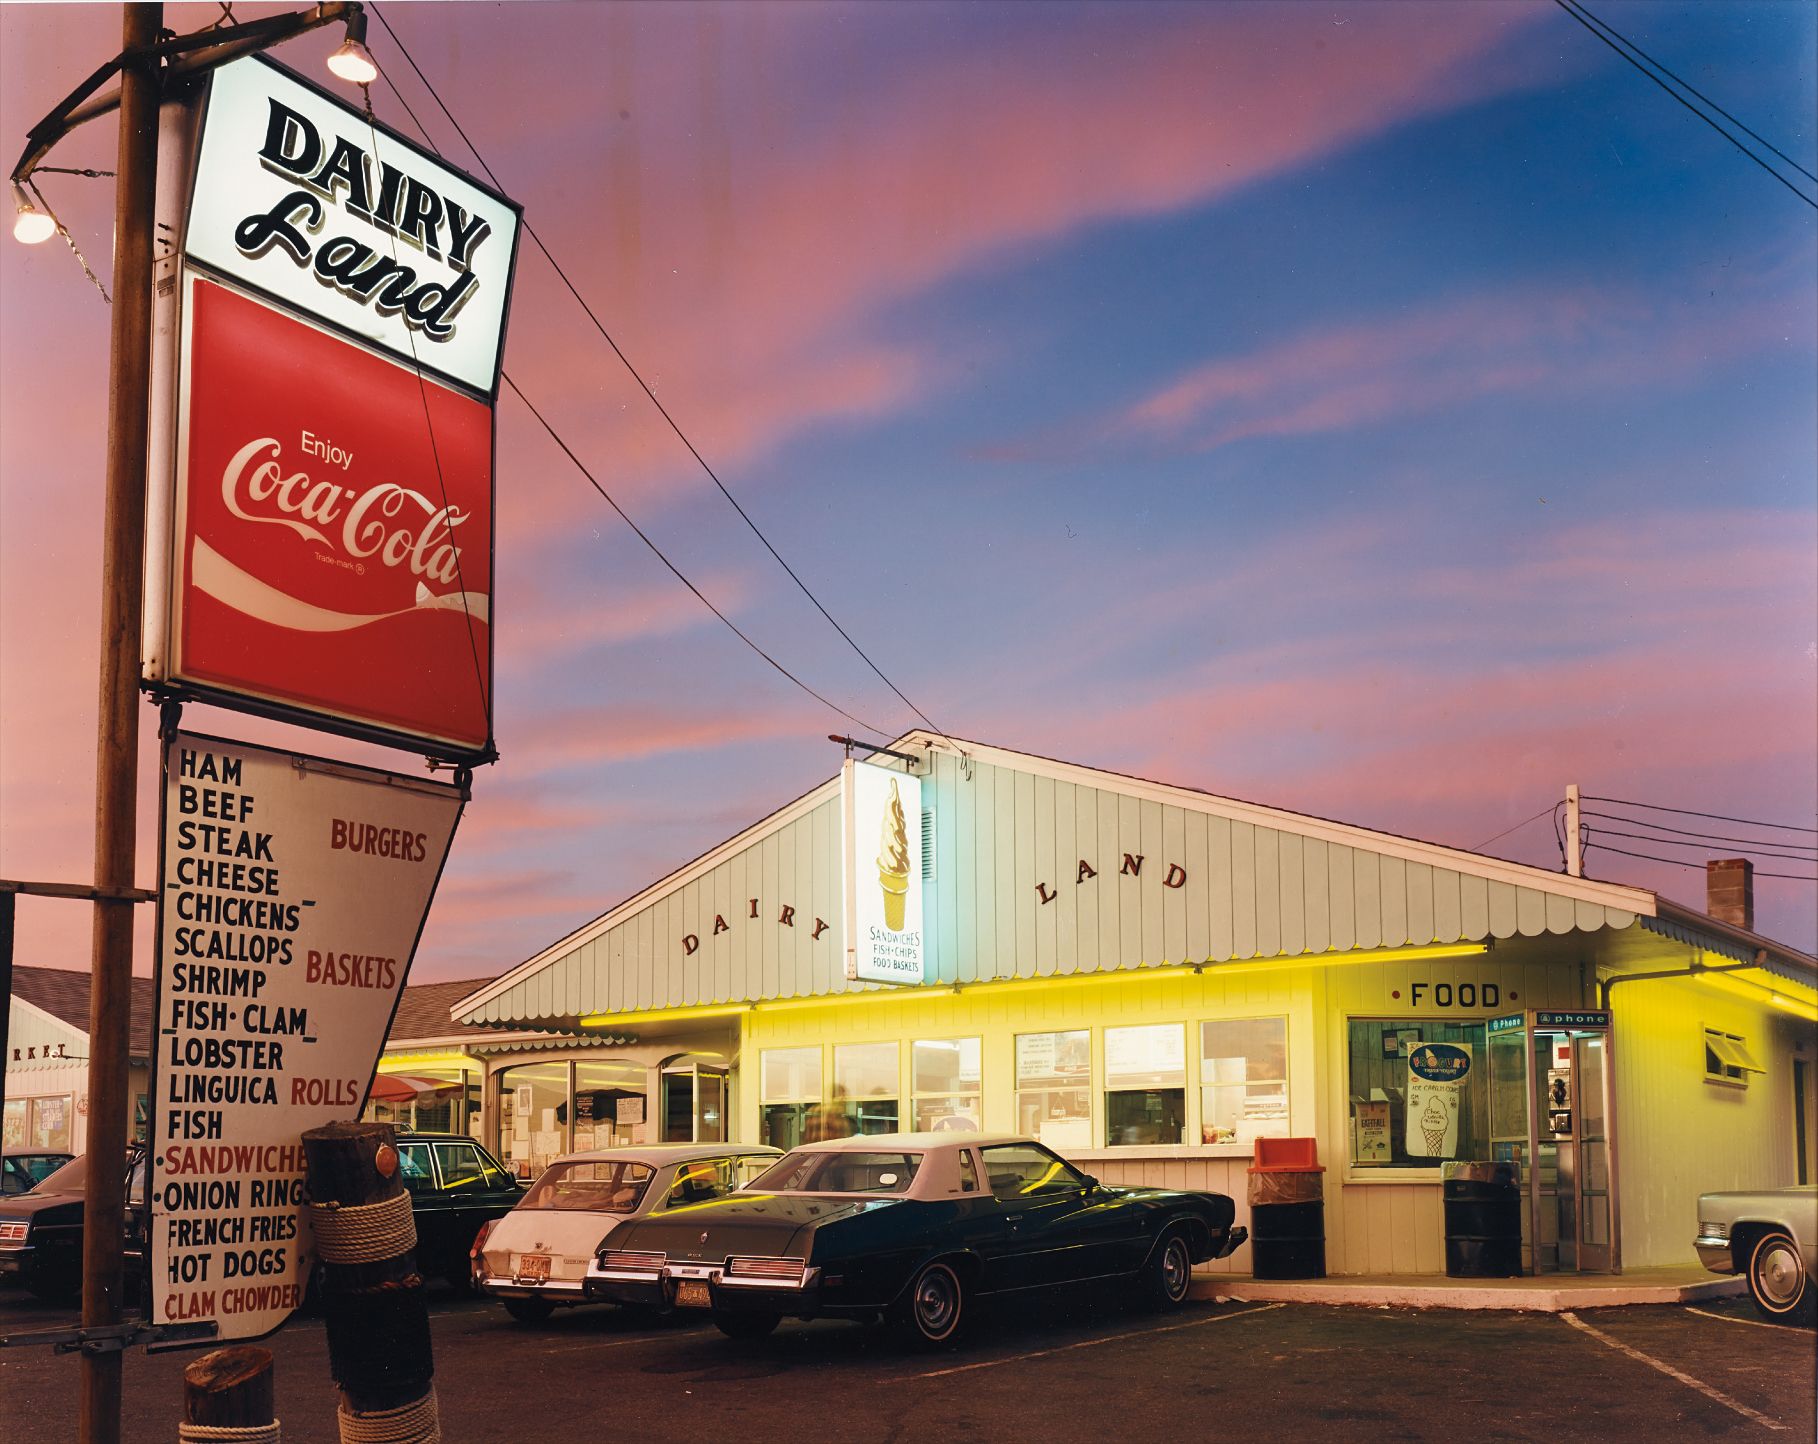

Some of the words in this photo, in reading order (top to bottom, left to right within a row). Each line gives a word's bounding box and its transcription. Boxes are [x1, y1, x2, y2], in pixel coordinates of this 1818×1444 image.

[257, 96, 491, 268] DAIRY
[235, 191, 479, 342] Land
[301, 430, 353, 470] Enjoy
[221, 437, 471, 584] Coca-Cola
[180, 748, 242, 786] HAM
[179, 784, 254, 823] BEEF
[178, 821, 274, 862] STEAK
[331, 818, 427, 863] BURGERS
[176, 857, 279, 896] CHEESE
[176, 891, 300, 932] CHICKENS
[682, 898, 829, 956] DAIRY
[1036, 853, 1187, 905] LAND
[870, 926, 920, 947] SANDWICHES
[174, 927, 293, 965] SCALLOPS
[306, 950, 396, 989] BASKETS
[873, 956, 891, 968] FOOD
[893, 960, 919, 972] BASKETS
[172, 963, 266, 998] SHRIMP
[1411, 983, 1500, 1007] FOOD
[243, 1004, 307, 1036] CLAM
[1555, 1014, 1605, 1023] phone
[170, 1037, 283, 1070] LOBSTER
[169, 1074, 278, 1105] LINGUICA
[291, 1077, 358, 1106] ROLLS
[168, 1110, 223, 1139] FISH
[165, 1145, 308, 1175] SANDWICHE
[163, 1180, 241, 1211] ONION
[251, 1179, 308, 1208] RING
[168, 1216, 245, 1248] FRENCH
[250, 1214, 297, 1243] FRIES
[168, 1253, 211, 1284] HOT
[223, 1248, 286, 1279] DOGS
[165, 1290, 215, 1321] CLAM
[221, 1283, 300, 1314] CHOWDER
